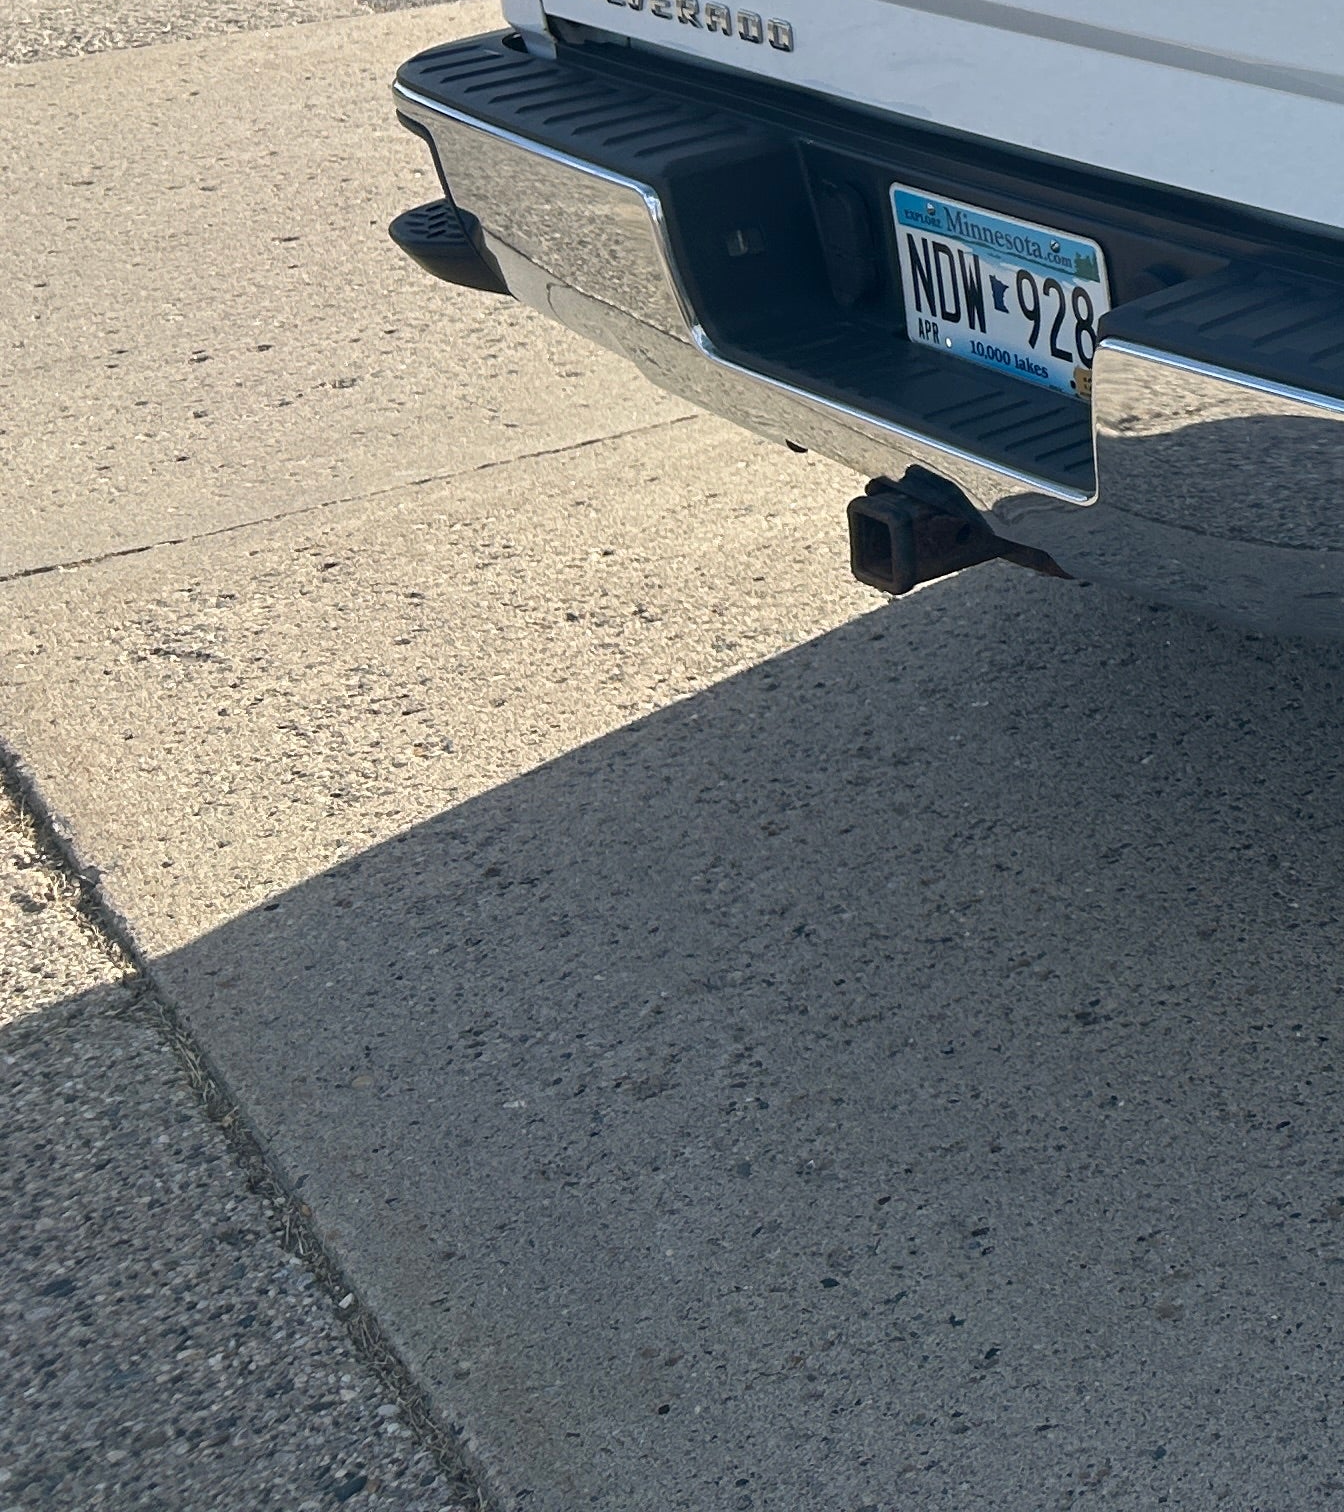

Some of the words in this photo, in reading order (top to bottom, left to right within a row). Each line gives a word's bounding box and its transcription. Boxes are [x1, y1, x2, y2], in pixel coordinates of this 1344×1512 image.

[907, 233, 987, 334] NDW
[1016, 269, 1099, 370] 928
[918, 317, 940, 344] APR
[970, 340, 1011, 366] 10,000
[1014, 354, 1049, 379] lakes
